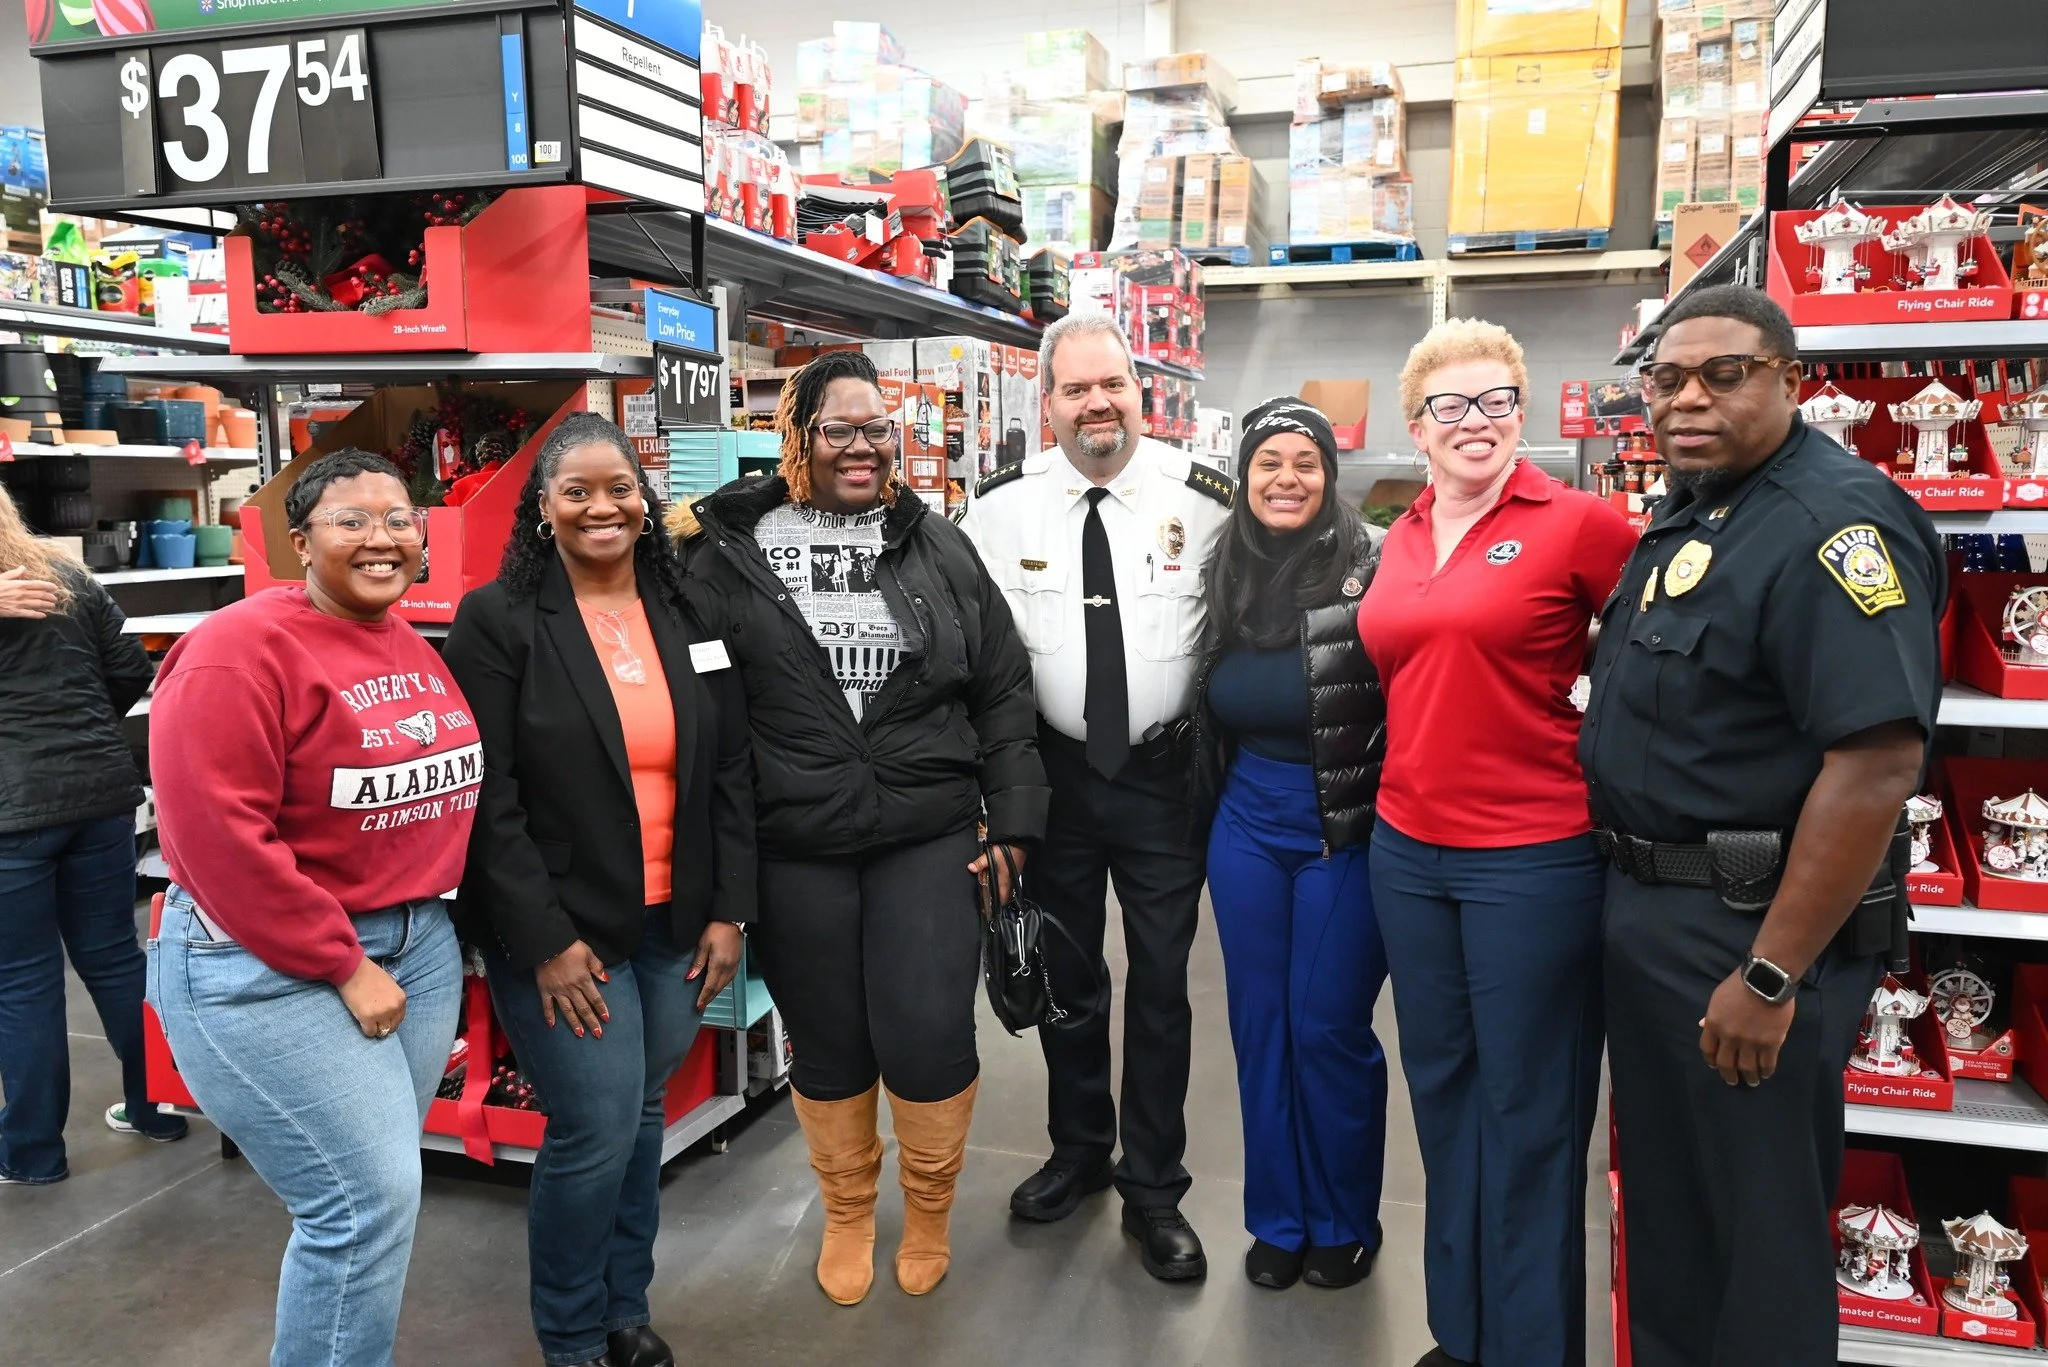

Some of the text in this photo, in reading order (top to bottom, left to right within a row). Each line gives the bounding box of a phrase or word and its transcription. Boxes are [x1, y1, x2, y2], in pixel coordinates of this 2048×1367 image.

[622, 46, 662, 76] Repellent
[512, 92, 518, 102] Y
[514, 122, 521, 132] 8
[540, 144, 552, 154] 100
[511, 154, 528, 164] 100
[658, 302, 680, 320] Everyday
[1898, 297, 1994, 312] Flying Chair Ride
[393, 324, 446, 334] 28-Inch Wreath
[659, 318, 695, 341] Low Price
[1925, 487, 1955, 497] Chair
[1958, 487, 1985, 497] Ride
[818, 516, 846, 528] TOUR
[1824, 530, 1876, 561] POLICE
[400, 600, 451, 609] 28-Inch Wreath
[428, 673, 447, 696] OF
[361, 710, 471, 748] EST. 1831
[360, 800, 443, 831] CRIMSON
[1920, 884, 1944, 893] Ride
[1848, 1083, 1936, 1098] Flying Chair Ride
[1877, 1311, 1921, 1324] Carousel
